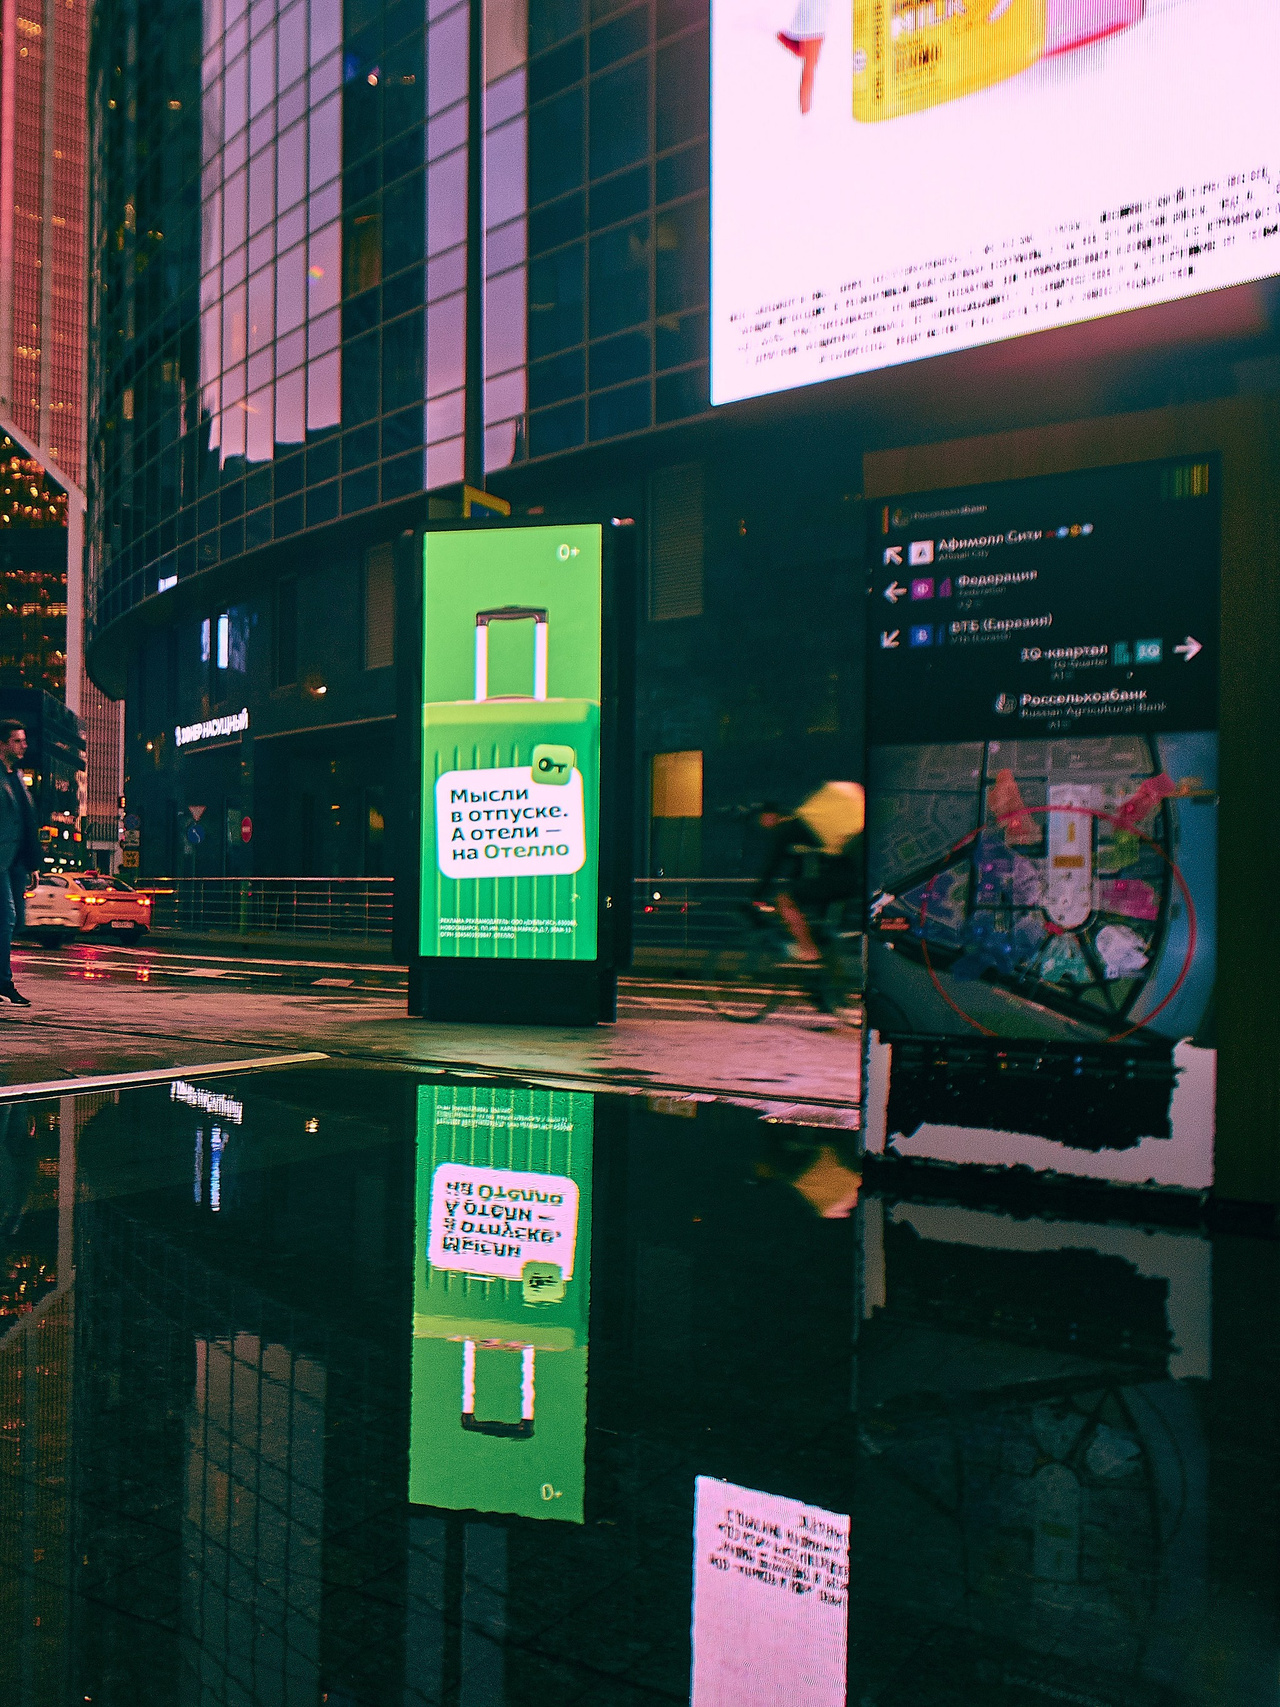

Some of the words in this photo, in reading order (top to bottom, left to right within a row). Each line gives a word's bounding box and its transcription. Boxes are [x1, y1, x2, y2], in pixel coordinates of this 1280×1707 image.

[938, 534, 1005, 552] Афимолл
[1007, 529, 1043, 544] Сити
[957, 570, 1039, 587] Федерация
[950, 619, 980, 635] ВТБ
[1021, 688, 1148, 707] Россельхозбанк
[450, 788, 529, 804] Мысли
[451, 810, 463, 823] в
[468, 806, 569, 824] отпуске.
[451, 826, 466, 842] А
[470, 825, 539, 841] отели
[452, 847, 479, 861] на
[483, 844, 570, 859] Отелло
